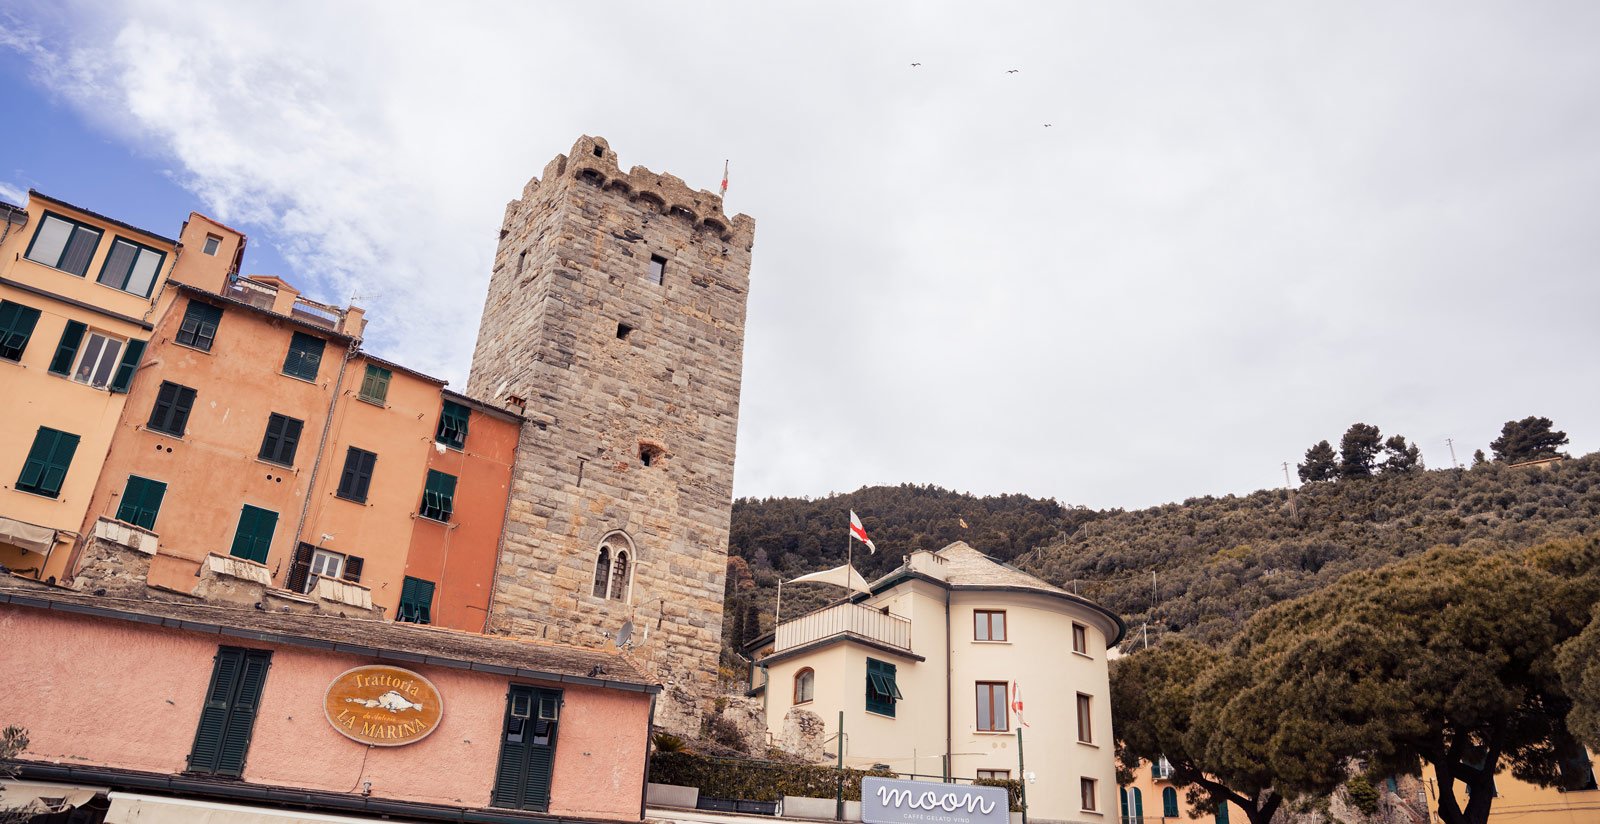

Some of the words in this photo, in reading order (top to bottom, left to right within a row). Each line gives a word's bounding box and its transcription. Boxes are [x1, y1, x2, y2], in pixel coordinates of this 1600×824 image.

[353, 674, 419, 697] Trattoria
[336, 708, 356, 730] LA
[360, 718, 426, 739] MARINA
[877, 785, 996, 814] moon
